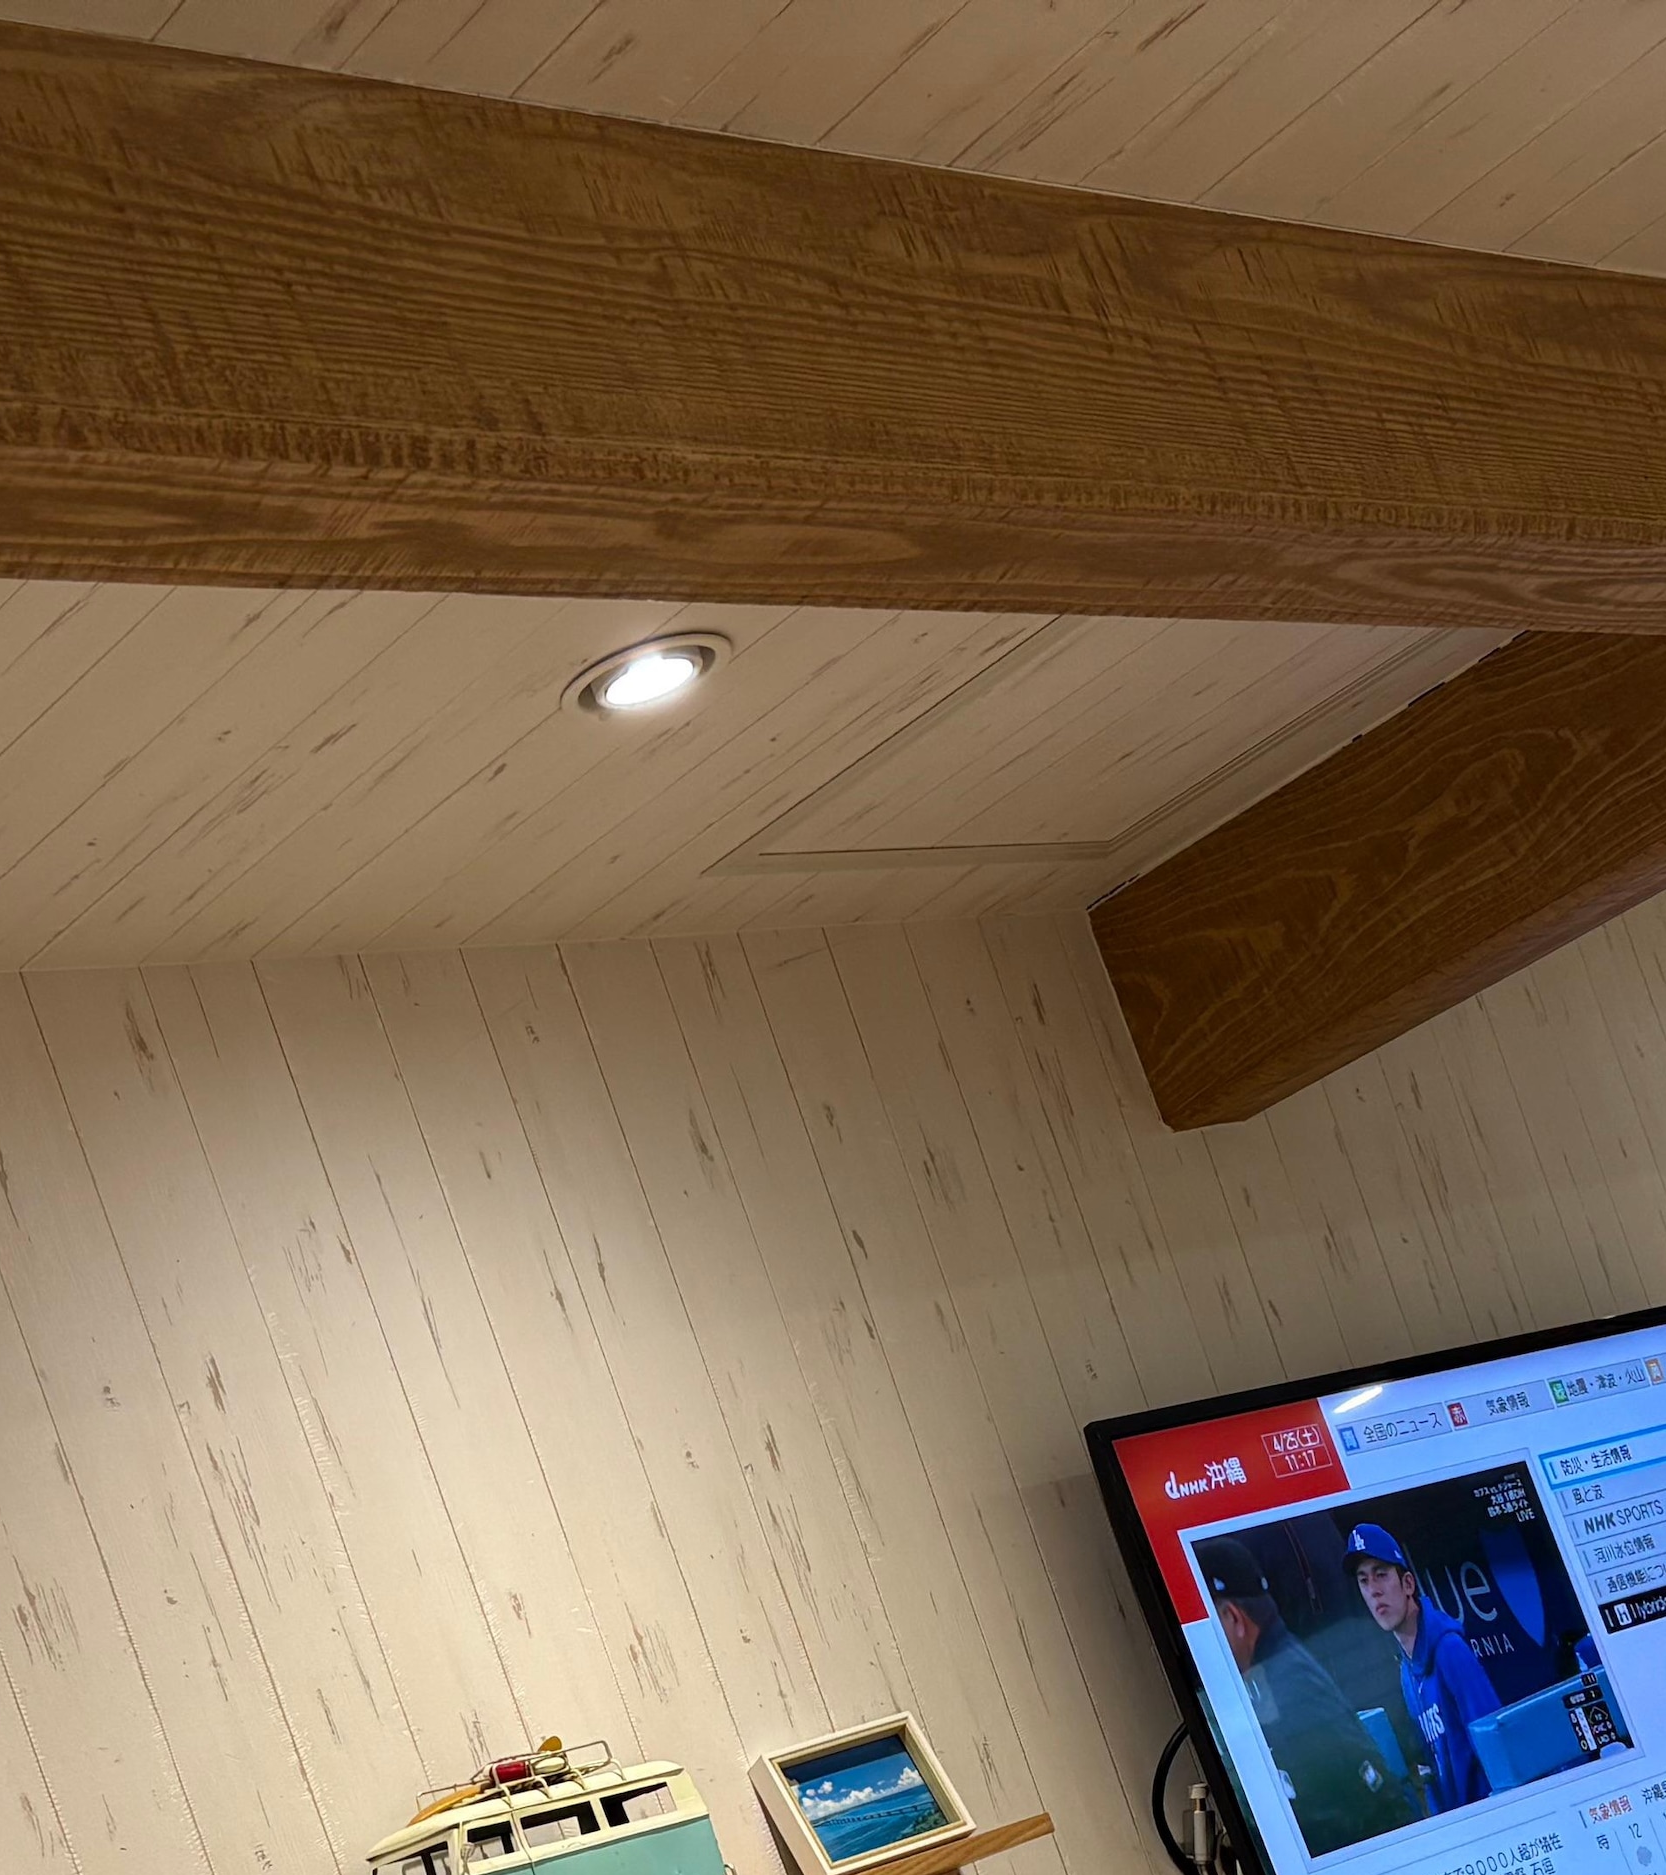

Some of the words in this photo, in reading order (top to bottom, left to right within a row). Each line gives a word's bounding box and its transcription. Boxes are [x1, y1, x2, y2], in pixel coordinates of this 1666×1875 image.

[1485, 1391, 1531, 1416] 気象情報
[1271, 1427, 1321, 1453] 4/25(土)
[1363, 1412, 1443, 1444] 全国のニュース
[1284, 1449, 1317, 1471] 11:17
[1515, 1507, 1536, 1523] LIVE
[1583, 1512, 1617, 1535] NHK
[1615, 1499, 1665, 1526] SPORTS
[1593, 1533, 1656, 1564] 河川水位情報
[1589, 1794, 1633, 1825] 気象情報
[1596, 1834, 1610, 1850] 時
[1627, 1822, 1643, 1839] 12
